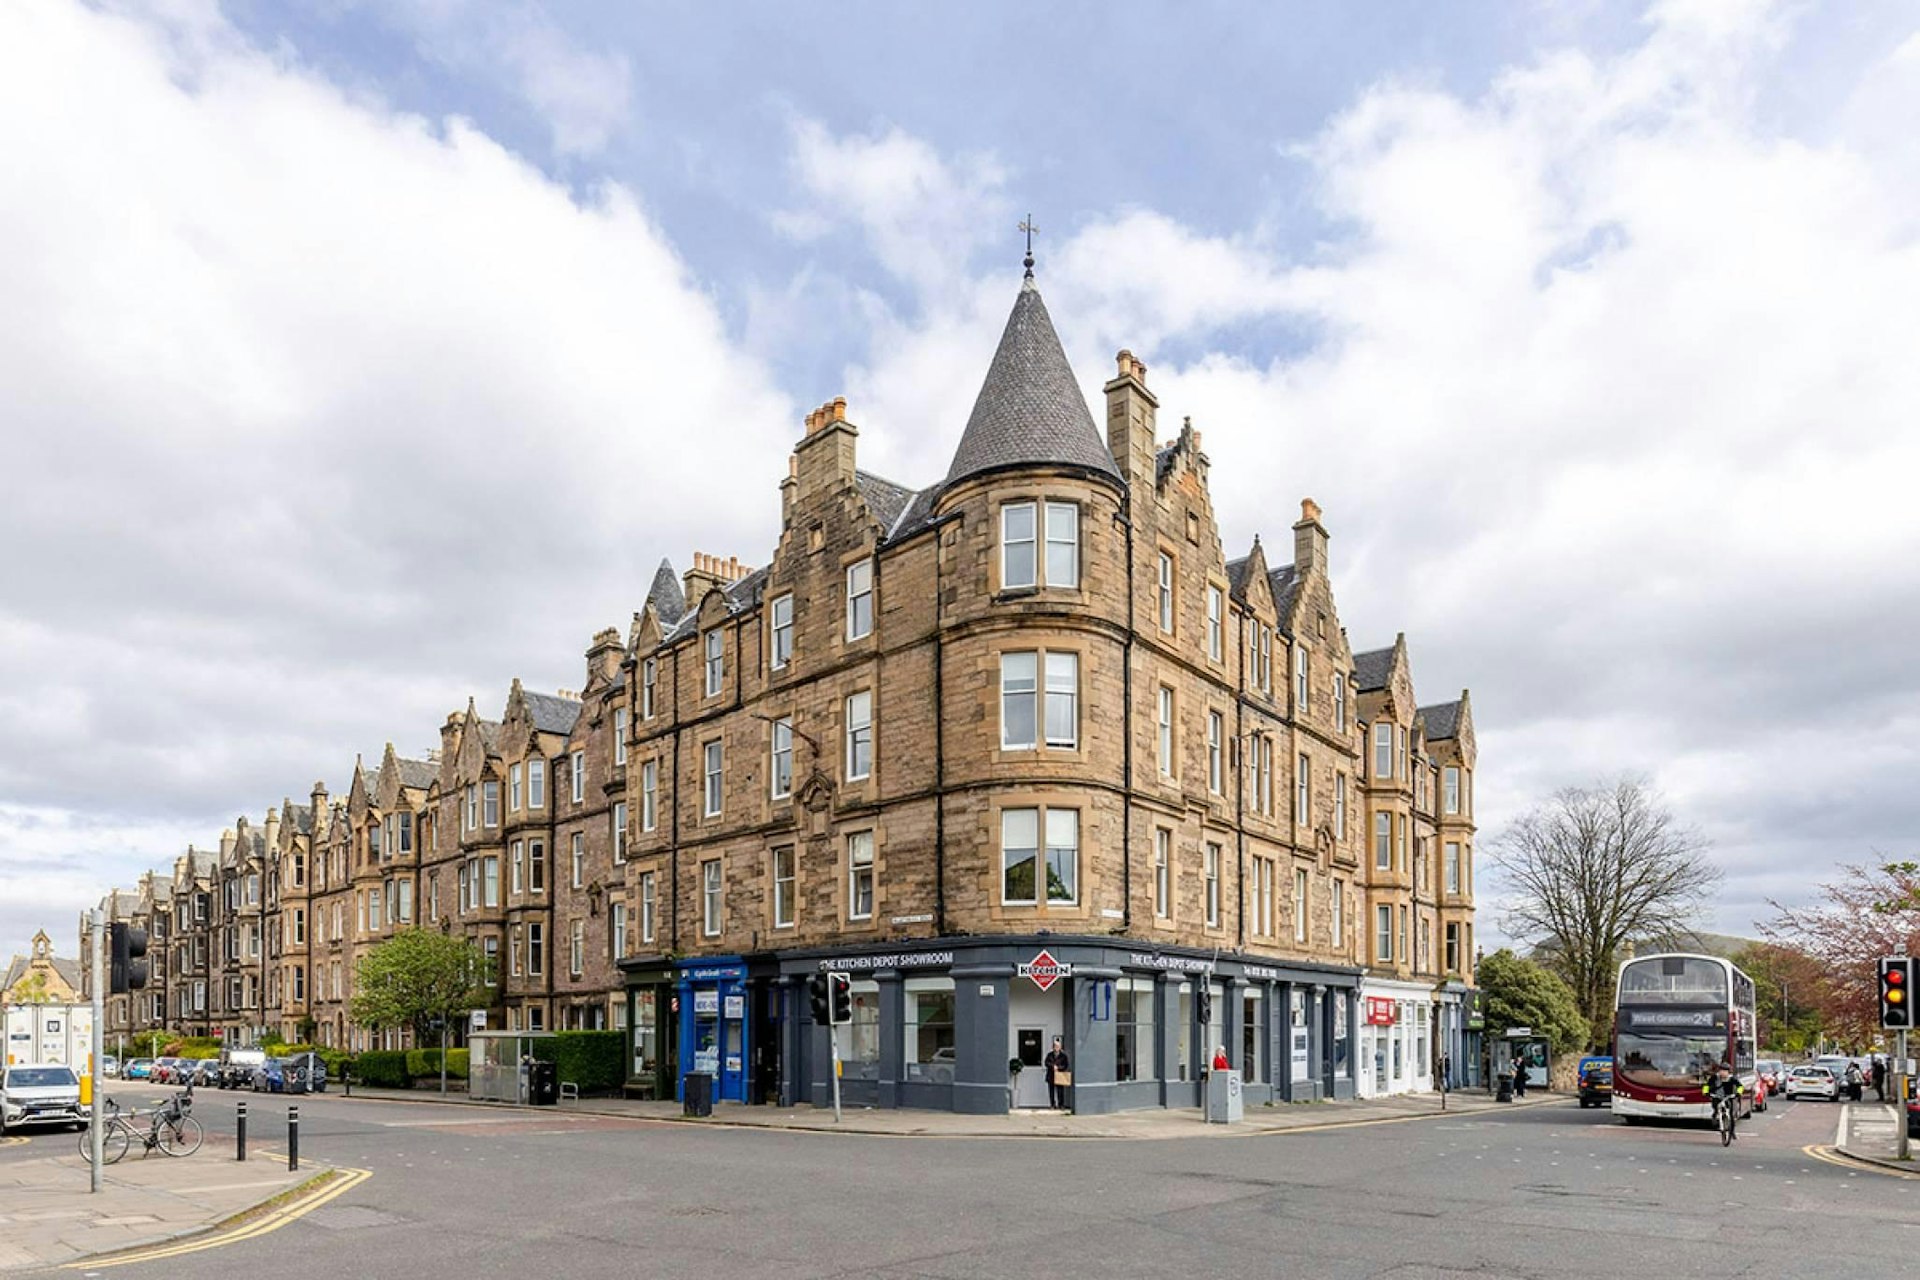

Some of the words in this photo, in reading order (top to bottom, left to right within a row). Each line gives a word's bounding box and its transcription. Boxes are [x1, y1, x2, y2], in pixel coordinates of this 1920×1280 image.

[837, 957, 872, 969] KITCHEN
[873, 955, 899, 967] DEPOT
[900, 952, 953, 965] SHOWROOM
[1020, 966, 1069, 975] KITCHEN
[1694, 1013, 1712, 1024] 24
